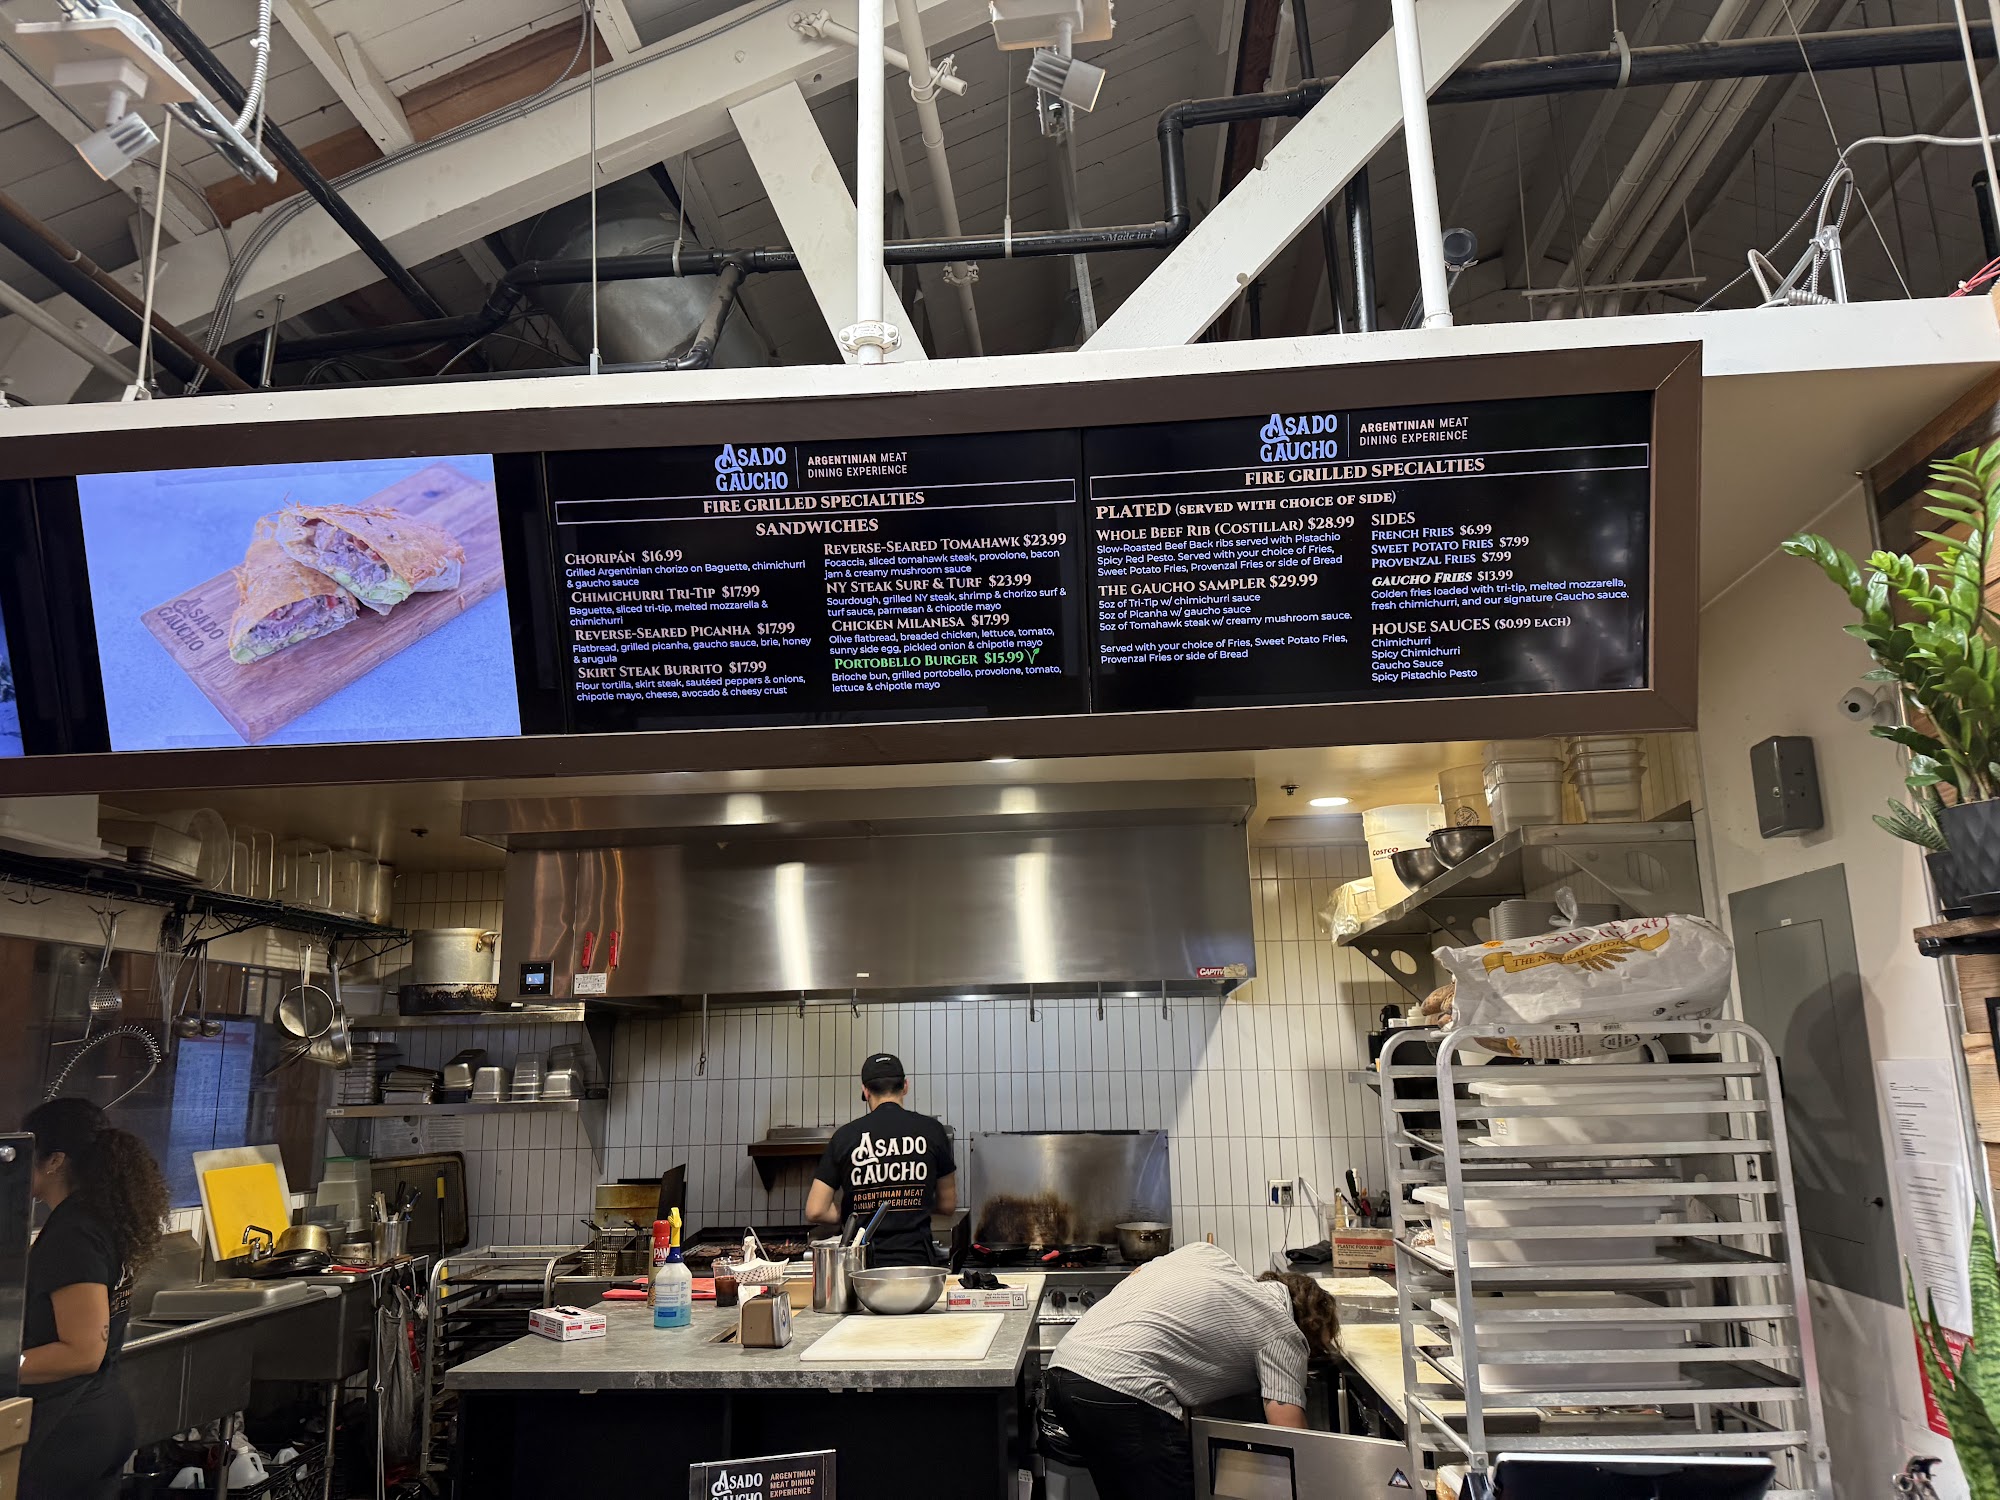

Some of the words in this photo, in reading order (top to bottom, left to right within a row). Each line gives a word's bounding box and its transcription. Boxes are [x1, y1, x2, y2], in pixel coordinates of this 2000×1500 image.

[1108, 232, 1134, 242] Made
[1260, 414, 1337, 444] ASADO
[1360, 419, 1435, 433] ARGENTINIAN
[1440, 417, 1468, 428] MEAT
[1360, 434, 1397, 446] DINING
[1402, 430, 1468, 443] EXPERIENCE
[715, 444, 786, 473] ASADO
[1260, 440, 1337, 462] GAUCHO
[808, 454, 877, 466] ARGENTINIAN
[881, 452, 907, 463] MEAT
[808, 468, 842, 478] DINING
[847, 465, 907, 476] EXPERIENCE
[1244, 470, 1285, 485] FIRE
[1288, 465, 1367, 482] GRILLED
[1371, 457, 1484, 477] SPECIALTIES
[716, 472, 788, 491] GAUCHO
[703, 499, 741, 513] FIRE
[743, 496, 816, 511] GRILLED
[820, 491, 924, 508] SPECIALTIES
[1095, 502, 1171, 519] PLATED
[1175, 502, 1233, 516] (SERVED
[1236, 499, 1275, 511] WITH
[1279, 496, 1333, 508] CHOICE
[1336, 494, 1355, 505] OF
[1358, 489, 1396, 504] SIDE)
[1307, 515, 1354, 530] $28.99
[1371, 511, 1415, 526] SIDES
[755, 518, 878, 536] SANDWICHES
[1459, 523, 1491, 535] $6.99
[1023, 532, 1066, 547] $23.99
[1499, 536, 1529, 548] $7.99
[641, 549, 682, 562] $16.99
[1481, 550, 1511, 562] $7.99
[565, 567, 595, 577] Grilled
[597, 565, 652, 577] Argentinian
[654, 564, 688, 573] chorizo
[704, 563, 750, 573] Baguette,
[751, 559, 805, 570] chimichurri
[1477, 569, 1513, 581] $13.99
[566, 579, 573, 588] &
[574, 578, 610, 589] gaucho
[932, 577, 944, 589] &
[988, 573, 1031, 587] $23.99
[1097, 584, 1127, 596] THE
[1130, 580, 1195, 594] GAUCHO
[1198, 577, 1266, 591] SAMPLER
[1269, 573, 1317, 588] $29.99
[1371, 589, 1407, 598] Golden
[1409, 587, 1431, 596] fries
[1433, 585, 1468, 595] loaded
[1470, 584, 1494, 593] with
[1496, 582, 1527, 593] tri-tip,
[1529, 580, 1566, 590] melted
[1568, 577, 1626, 588] mozzarella,
[721, 584, 759, 598] $17.99
[1098, 600, 1115, 609] 5oz
[1116, 598, 1127, 608] of
[1128, 597, 1158, 608] Tri-Tip
[1159, 595, 1172, 606] w/
[1173, 593, 1229, 605] chimichurri
[1371, 600, 1396, 610] fresh
[1398, 597, 1459, 608] chimichurri,
[1461, 596, 1481, 605] and
[1503, 594, 1553, 605] signature
[1554, 590, 1595, 601] Gaucho
[1596, 590, 1629, 599] sauce.
[173, 598, 224, 640] ASADO
[971, 613, 1009, 626] $17.99
[1098, 611, 1115, 620] 5oz
[1117, 609, 1127, 619] of
[1129, 608, 1167, 618] Picanha
[1169, 606, 1182, 616] w/
[1183, 606, 1220, 617] gaucho
[158, 607, 204, 651] GAUCHO
[756, 621, 794, 635] $17.99
[1372, 620, 1426, 635] HOUSE
[1430, 617, 1490, 632] SAUCES
[1534, 615, 1570, 627] EACH)
[1371, 635, 1431, 647] Chimichurri
[984, 650, 1024, 664] $15.99
[1371, 649, 1398, 660] Spicy
[1400, 645, 1460, 657] Chimichurri
[728, 660, 766, 673] $17.99
[1371, 660, 1410, 670] Gaucho
[1412, 659, 1443, 668] Sauce
[1371, 672, 1398, 682] Spicy
[1400, 669, 1447, 679] Pistachio
[1449, 669, 1477, 677] Pesto
[1372, 847, 1398, 856] COSTCO
[1513, 957, 1536, 967] THE
[851, 1132, 927, 1166] ASADO
[851, 1161, 928, 1186] GAUCHO
[854, 1190, 901, 1202] ARGENTINIAN
[878, 1198, 922, 1207] EPERIENCE
[770, 1469, 816, 1480] ARGENTINIAN
[711, 1470, 763, 1496] ASADO
[770, 1480, 789, 1489] MEAT
[791, 1478, 815, 1487] DINING
[770, 1487, 812, 1498] EXPERIENCE
